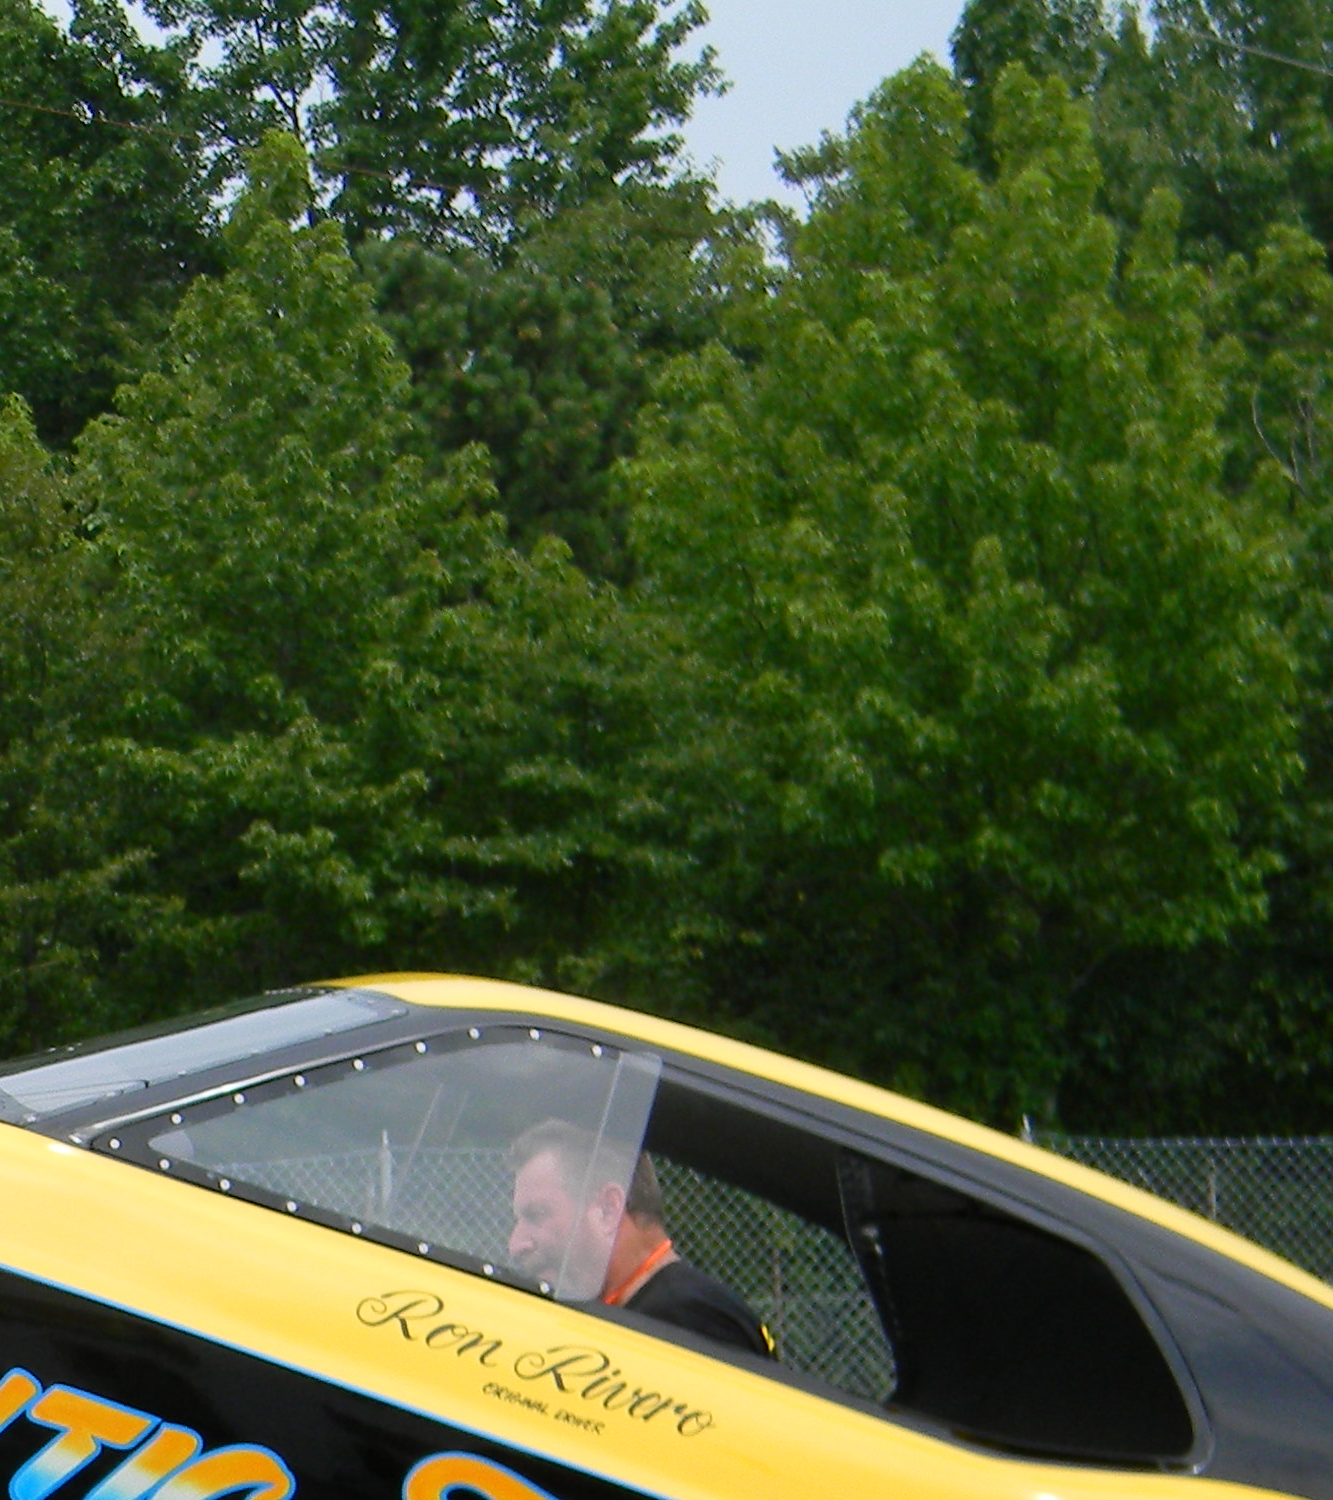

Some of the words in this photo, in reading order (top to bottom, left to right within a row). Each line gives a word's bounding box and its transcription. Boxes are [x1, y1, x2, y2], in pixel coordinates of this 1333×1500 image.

[356, 1290, 503, 1368] Ron
[513, 1344, 716, 1437] Rivero
[553, 1409, 606, 1436] DRIVER
